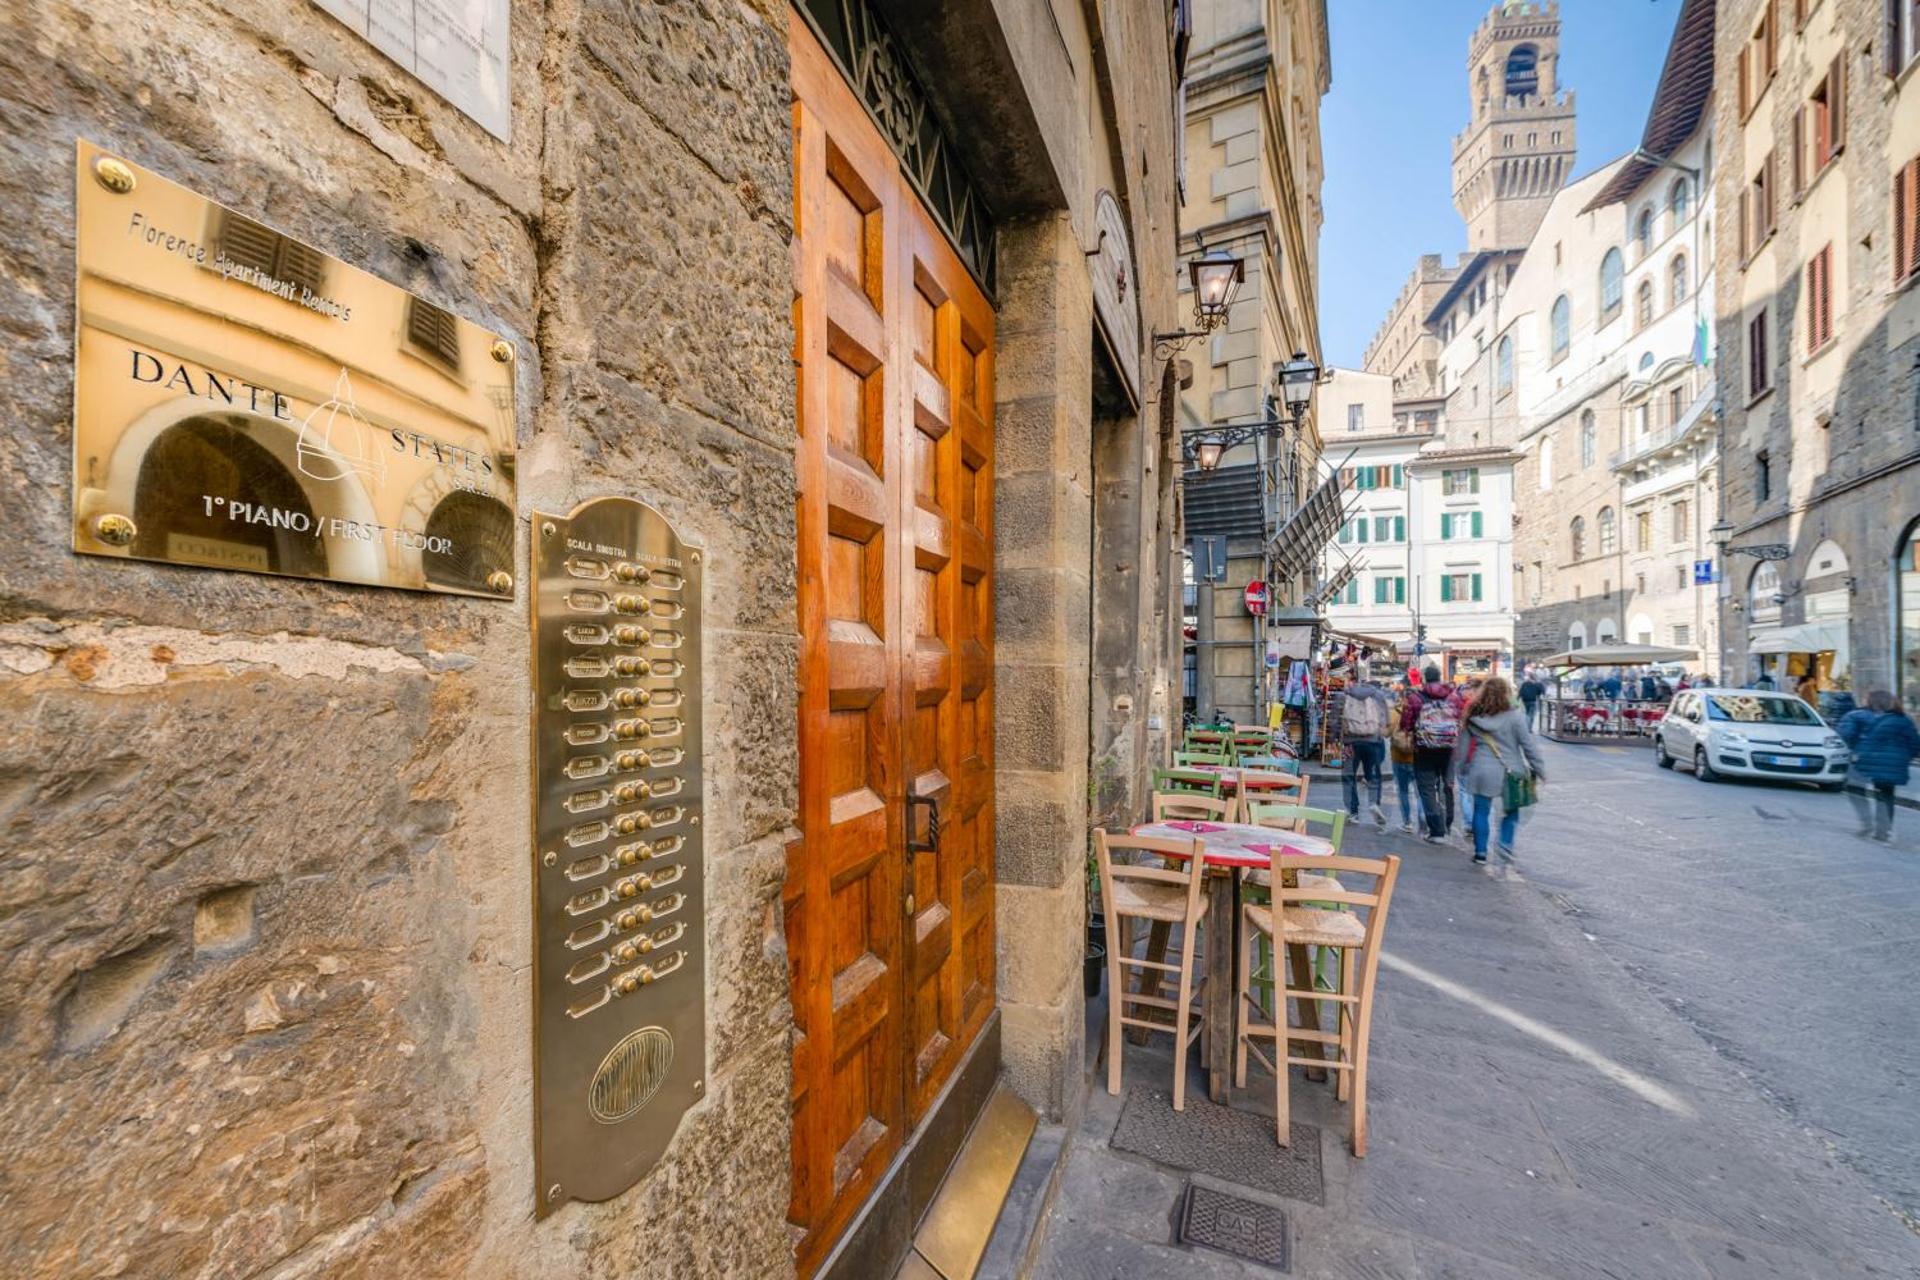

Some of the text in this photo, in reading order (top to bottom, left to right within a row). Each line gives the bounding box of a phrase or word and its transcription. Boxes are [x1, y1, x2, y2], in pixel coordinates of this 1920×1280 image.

[128, 212, 351, 321] Florence Apartment Rentals
[131, 350, 493, 475] DANTE STATES
[202, 495, 453, 556] 1° PIANO / FIRST FLOOR
[566, 538, 592, 552] SCALA
[1217, 1211, 1255, 1236] GAS
